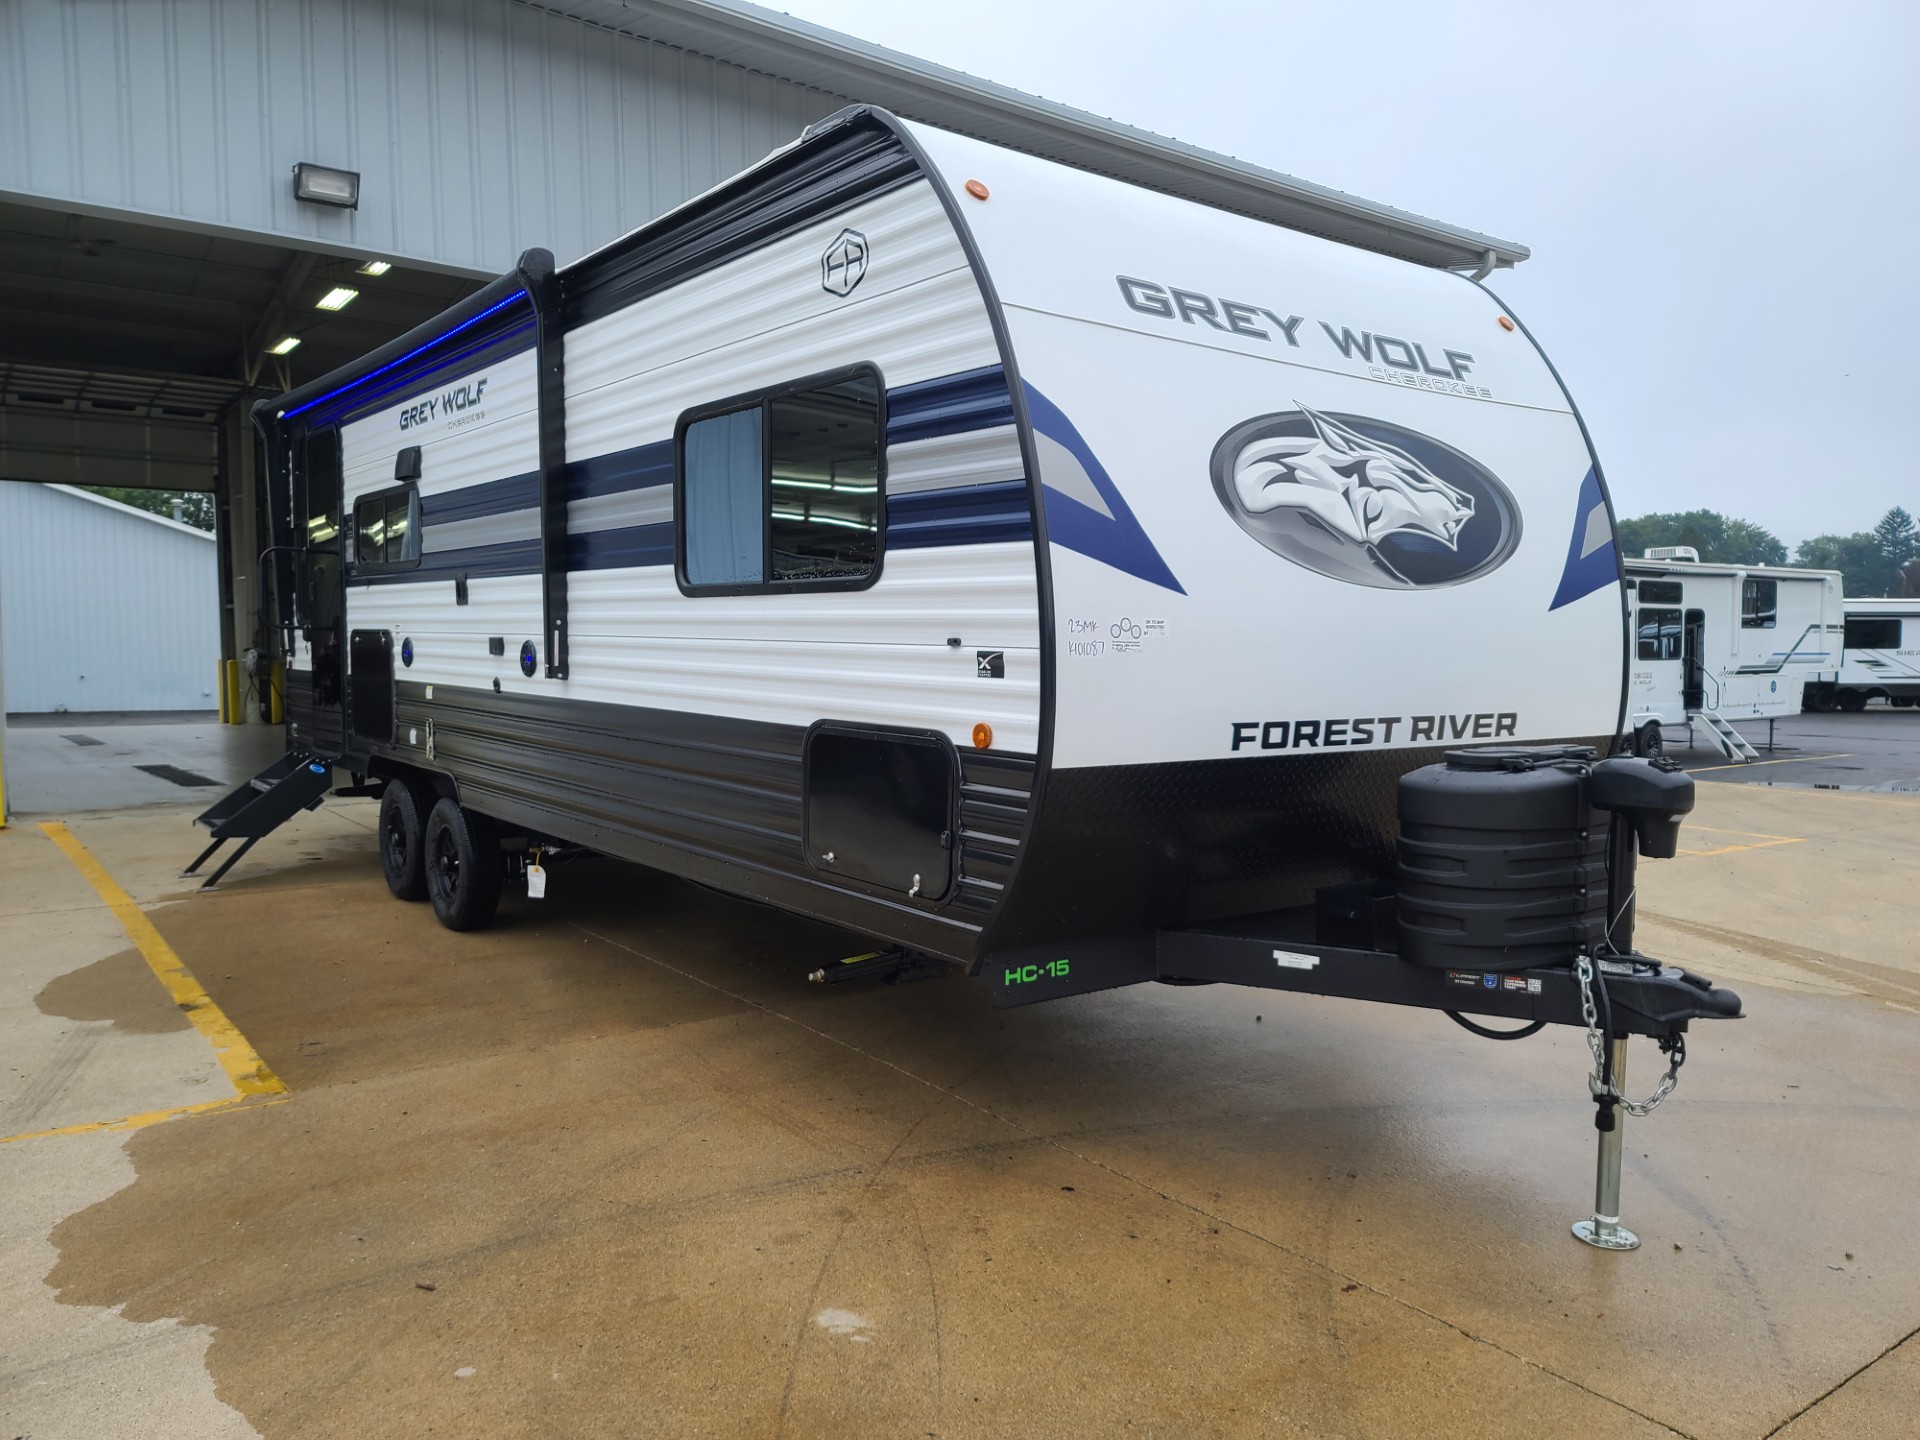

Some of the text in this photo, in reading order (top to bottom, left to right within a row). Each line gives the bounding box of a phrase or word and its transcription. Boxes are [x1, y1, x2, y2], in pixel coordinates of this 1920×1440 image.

[1115, 274, 1476, 382] GREY WOLF
[1367, 365, 1493, 399] CHEROKEE
[399, 378, 488, 431] GREY WOLF
[1230, 712, 1518, 751] FOREST RIVER
[1005, 959, 1070, 986] HC-15
